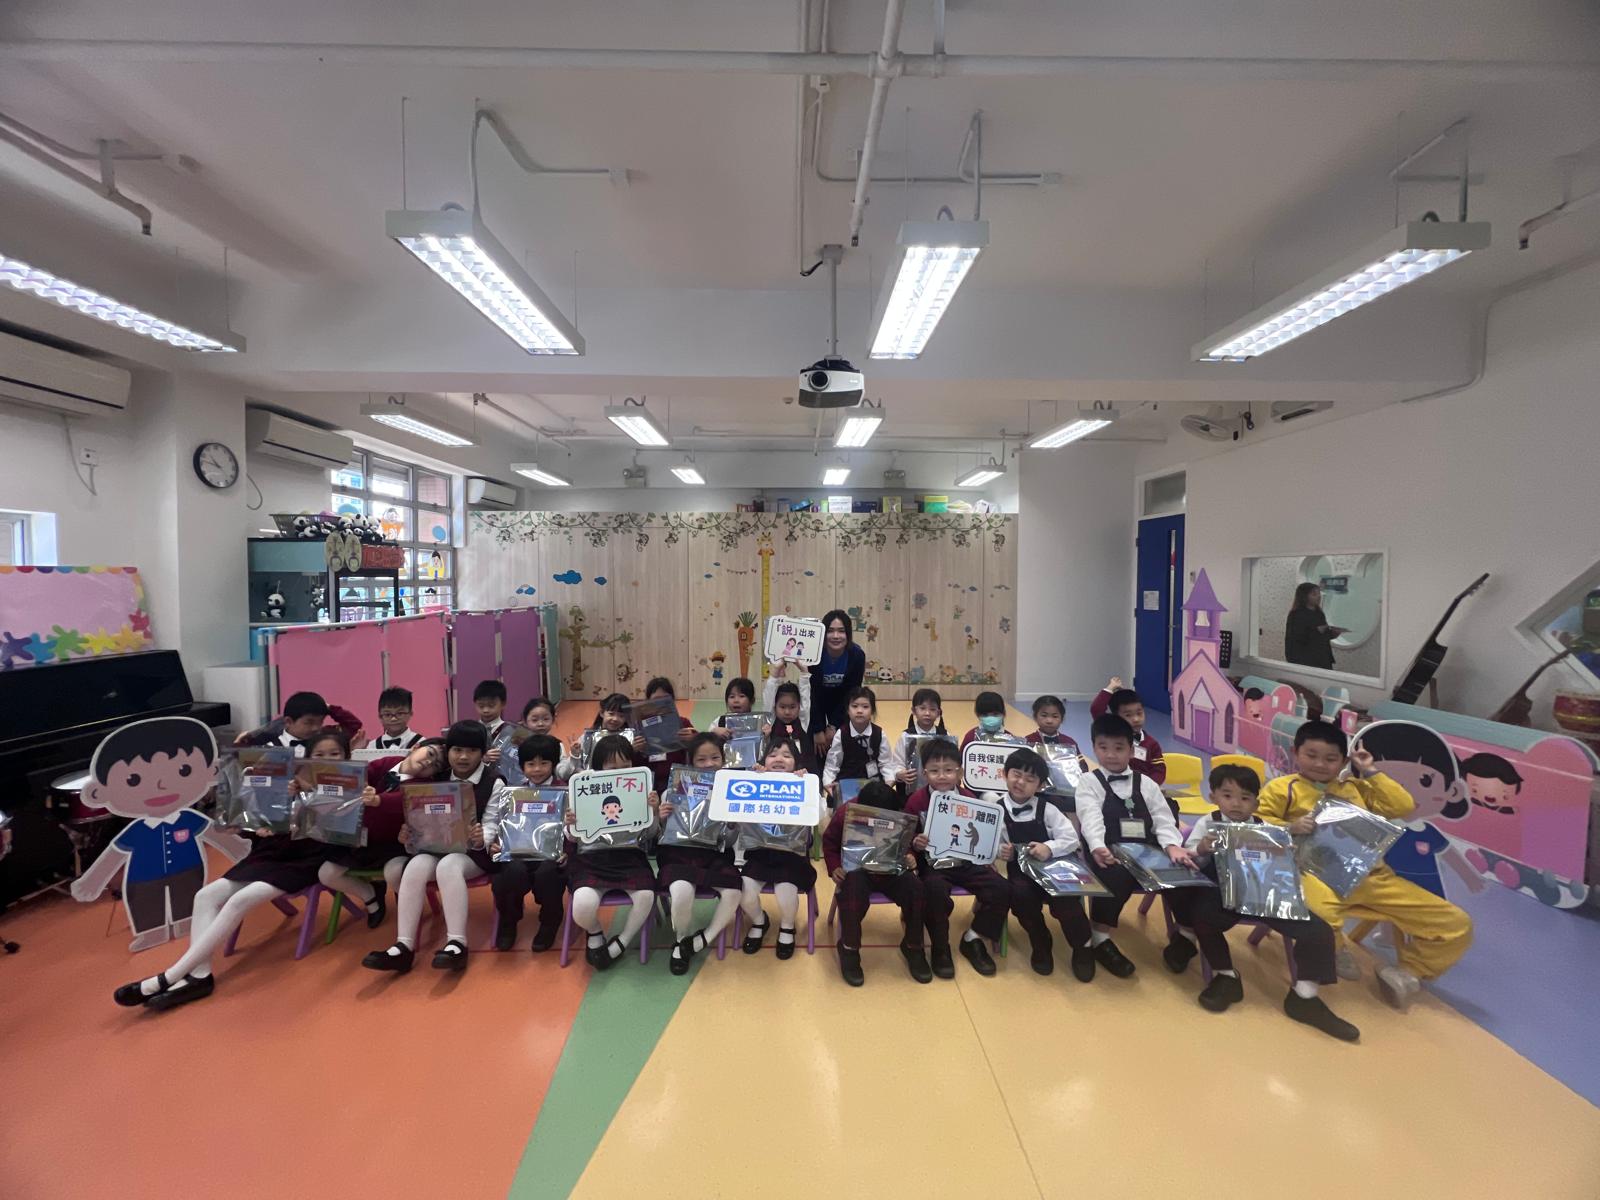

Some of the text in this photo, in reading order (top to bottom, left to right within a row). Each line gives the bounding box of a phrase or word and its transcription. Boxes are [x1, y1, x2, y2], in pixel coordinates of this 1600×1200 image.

[760, 783, 802, 795] PLAN
[728, 802, 800, 815] 國際培幼會
